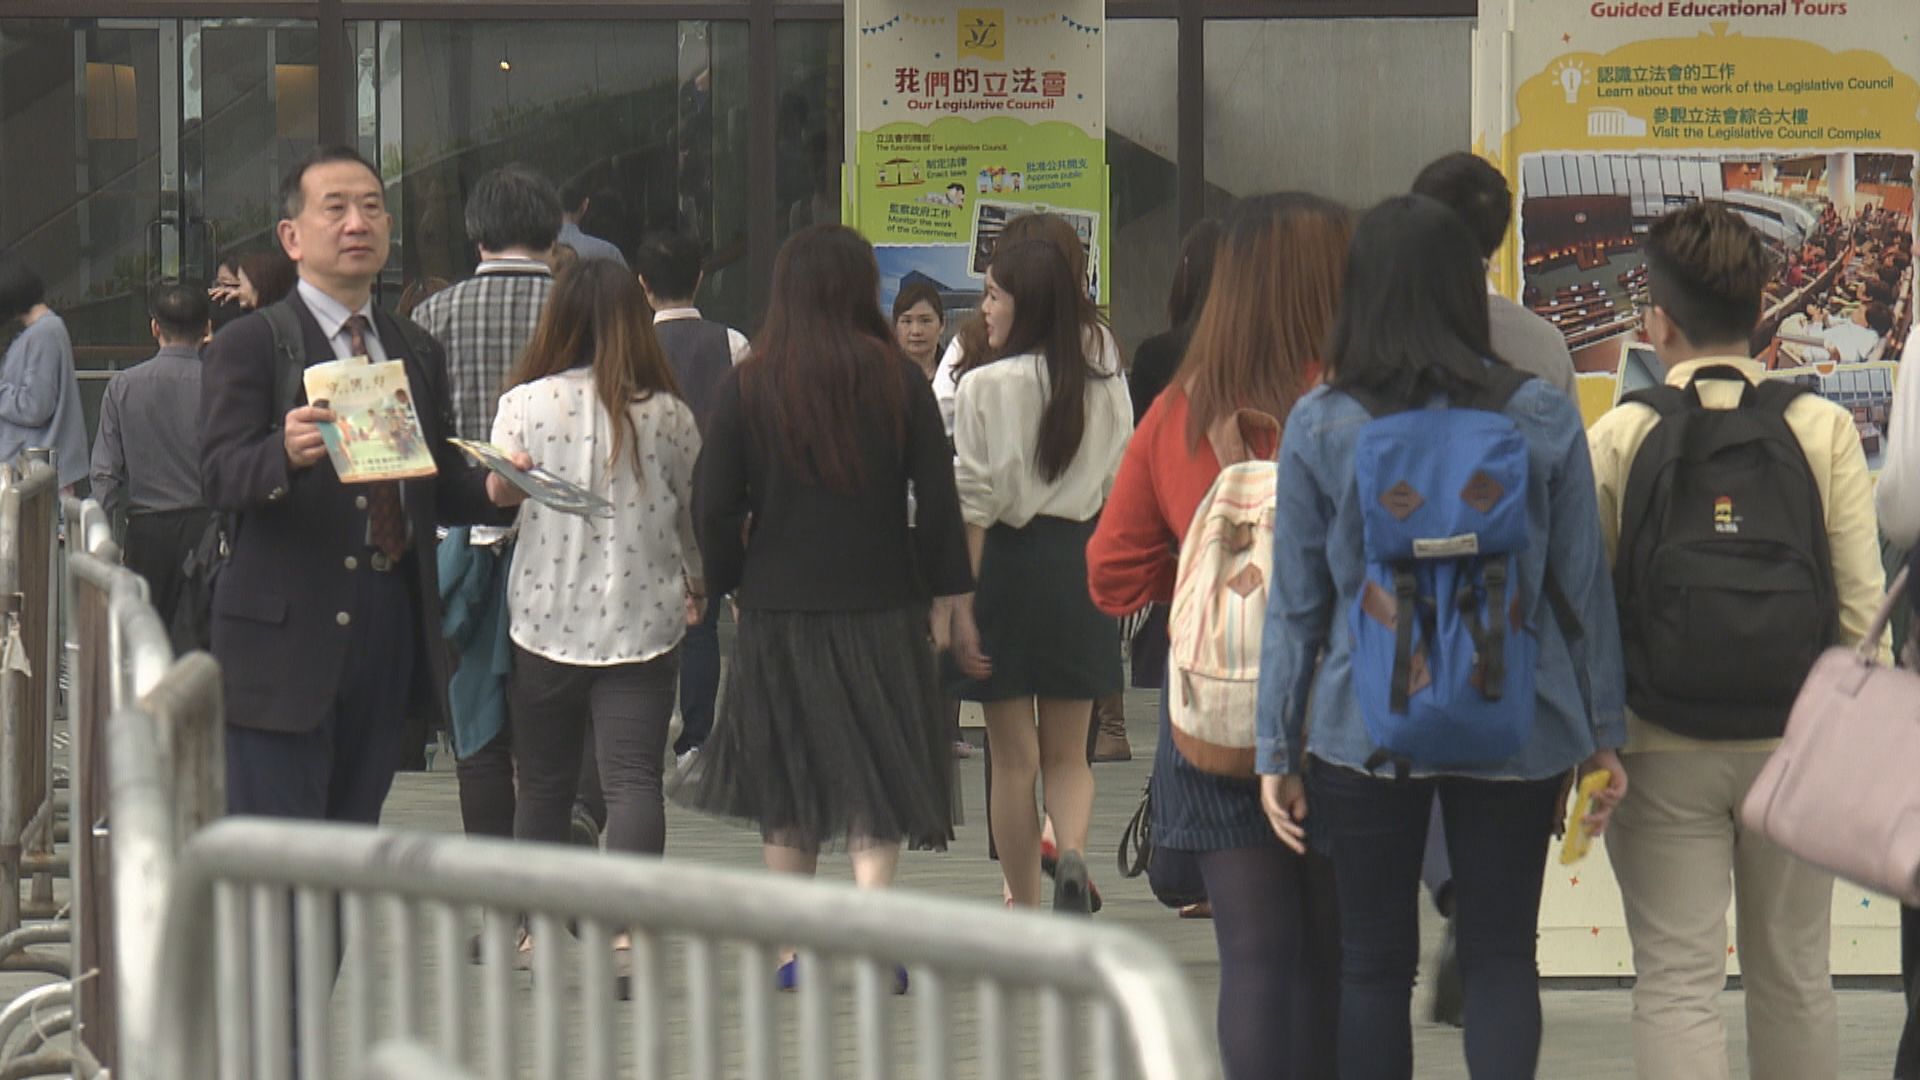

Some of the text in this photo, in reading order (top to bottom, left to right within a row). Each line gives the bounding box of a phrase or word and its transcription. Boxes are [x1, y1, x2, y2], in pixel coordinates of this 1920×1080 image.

[1590, 0, 1848, 18] Guided Educational Tours
[1597, 63, 1735, 83] 認識立法會的工作
[894, 67, 1067, 97] 我們的立法會
[1597, 76, 1894, 98] Learn about the work of the Legislative Council
[907, 98, 1055, 113] Our Legislative Council
[1653, 107, 1809, 126] 參觀立法會綜合大樓
[1652, 126, 1881, 142] Visit the Legislative Council Complex
[876, 143, 889, 151] The
[890, 143, 921, 152] functions
[923, 143, 931, 151] of
[932, 143, 943, 151] the
[945, 143, 980, 153] Legislative
[1026, 172, 1059, 182] Approve
[1027, 182, 1072, 192] expenditure
[888, 214, 952, 228] Monitor the work
[887, 224, 957, 238] of the Government
